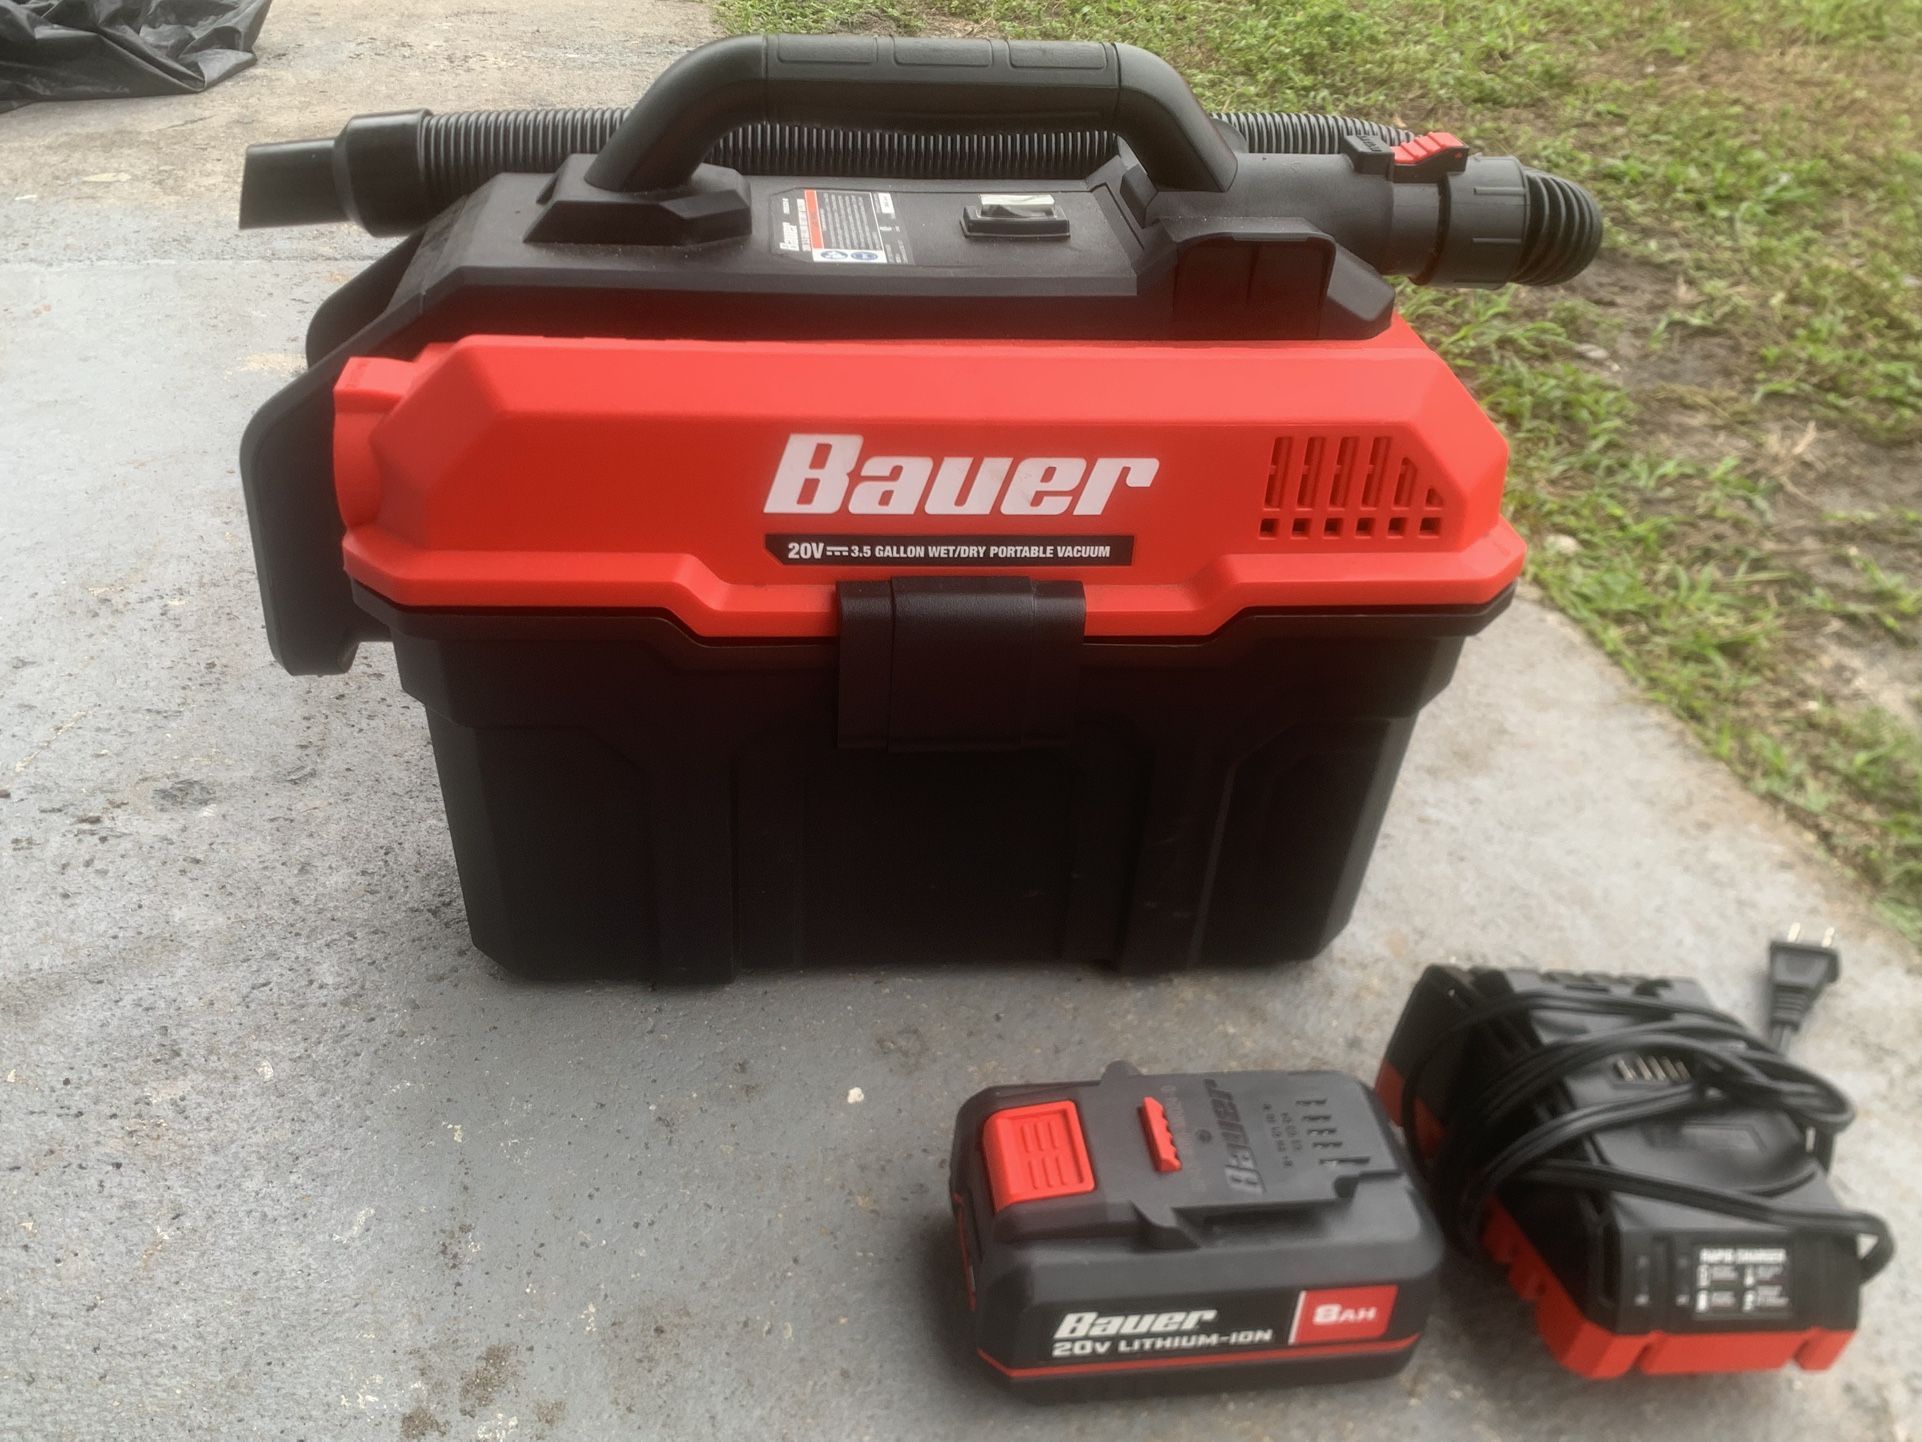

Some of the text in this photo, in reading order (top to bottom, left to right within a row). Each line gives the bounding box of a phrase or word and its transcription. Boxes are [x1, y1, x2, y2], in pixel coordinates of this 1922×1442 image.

[763, 433, 1160, 516] Bauer
[788, 542, 1111, 560] 20V 3.5 GALLON WET/DRY PORTABLE VACUUM
[1203, 1078, 1267, 1194] Bauer
[1053, 1309, 1218, 1339] Bauer
[1312, 1303, 1377, 1326] 8AH
[1117, 1329, 1274, 1356] LITHIUM-ION
